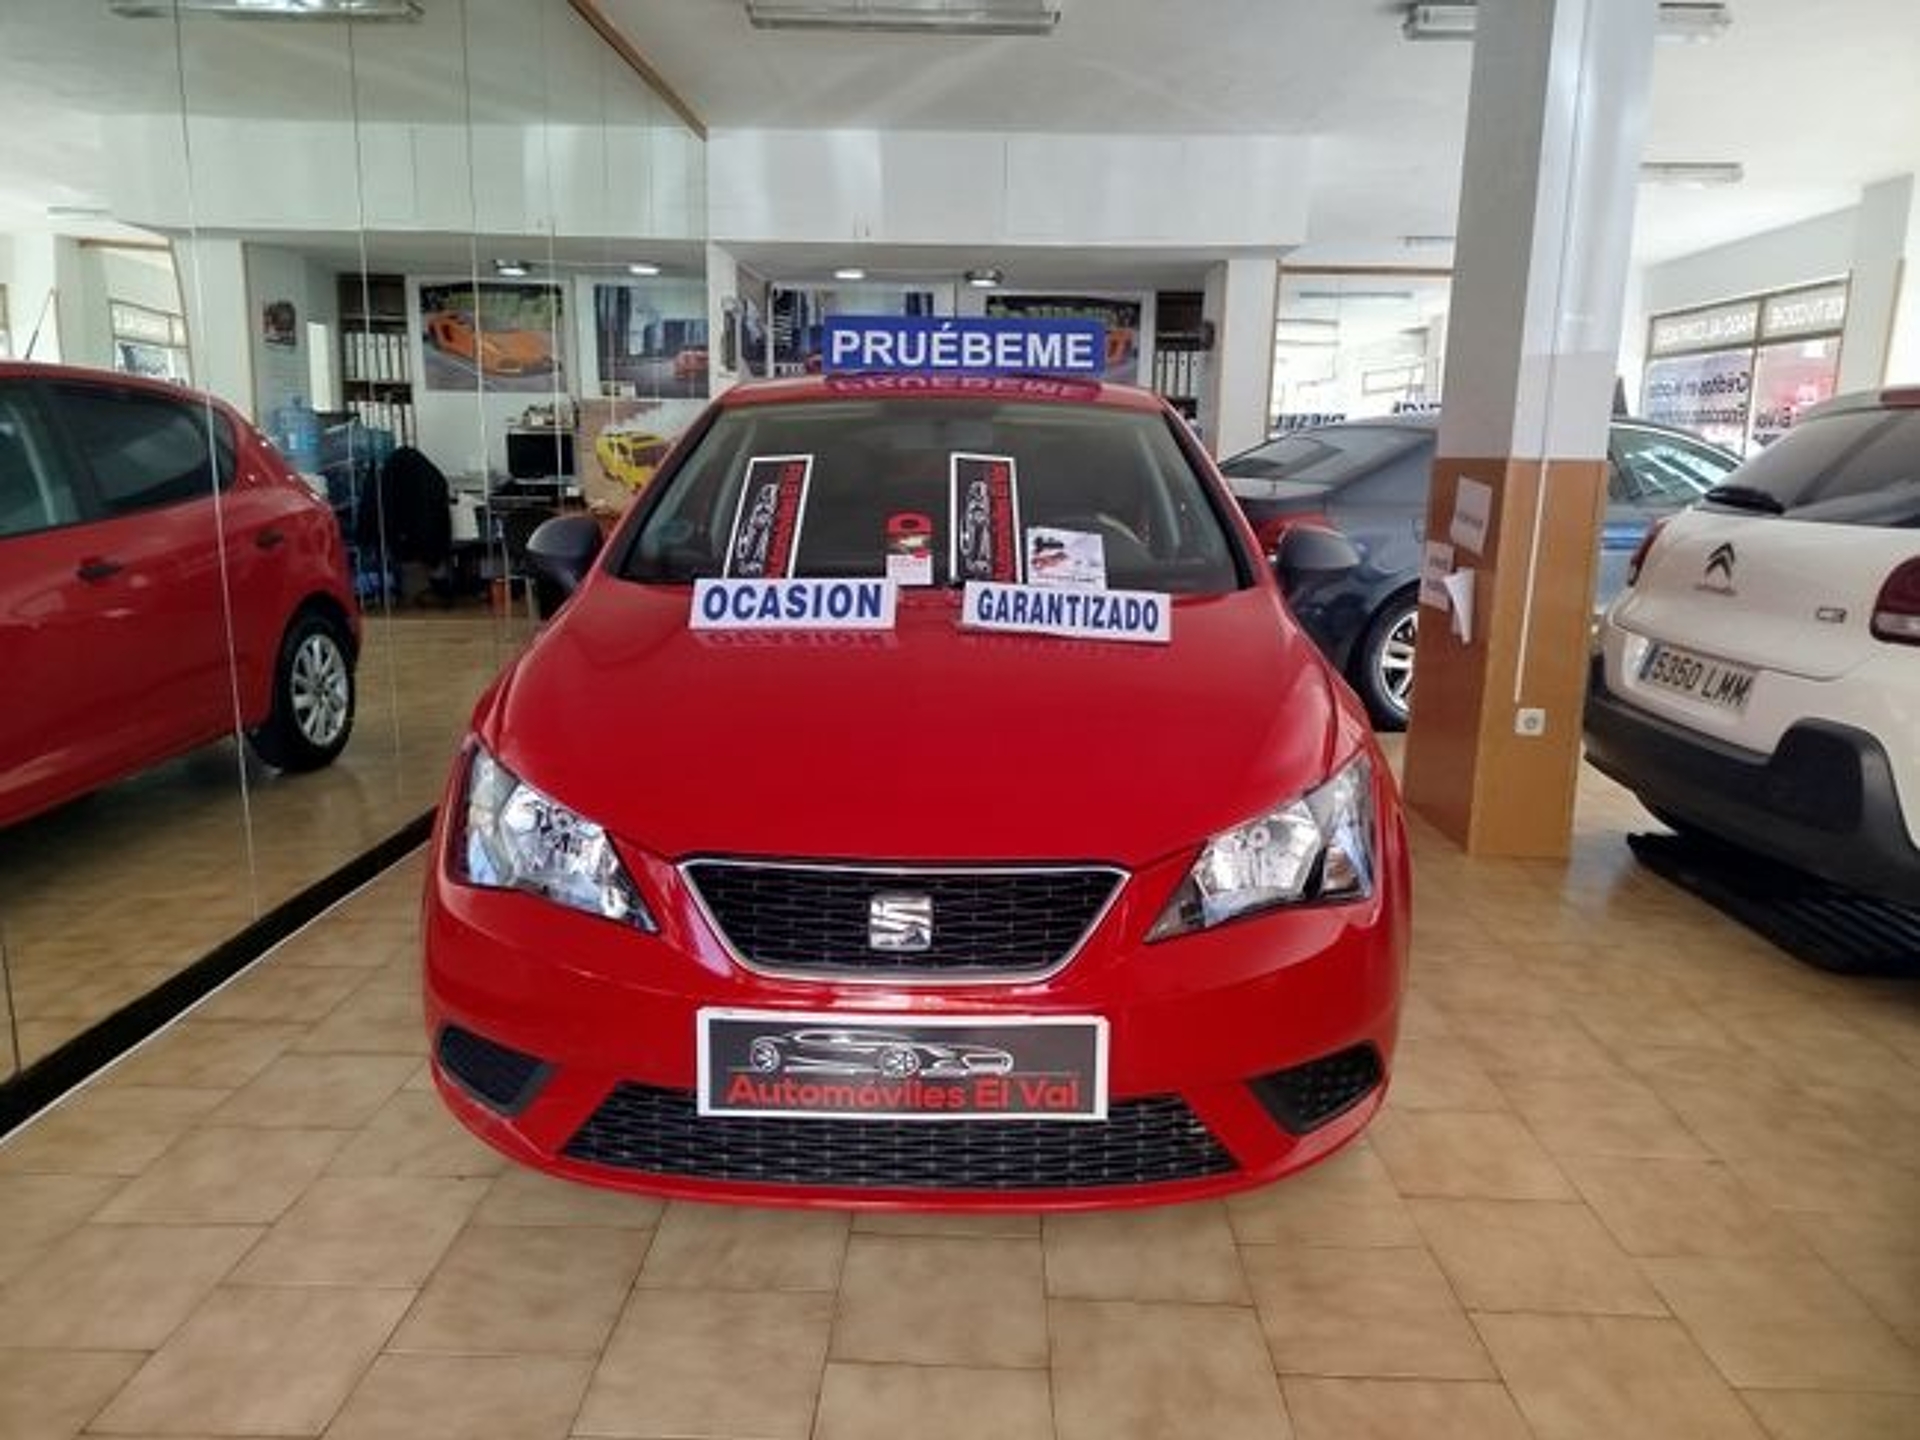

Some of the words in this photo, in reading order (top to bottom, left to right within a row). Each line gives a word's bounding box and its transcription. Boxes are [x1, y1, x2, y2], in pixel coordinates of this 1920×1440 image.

[831, 322, 1094, 368] PRUÉBEME
[703, 584, 881, 620] OCASION
[977, 588, 1159, 632] GARANTIZADO
[727, 1075, 967, 1108] Automóviles
[975, 1075, 1008, 1108] El
[1018, 1079, 1078, 1109] Val
